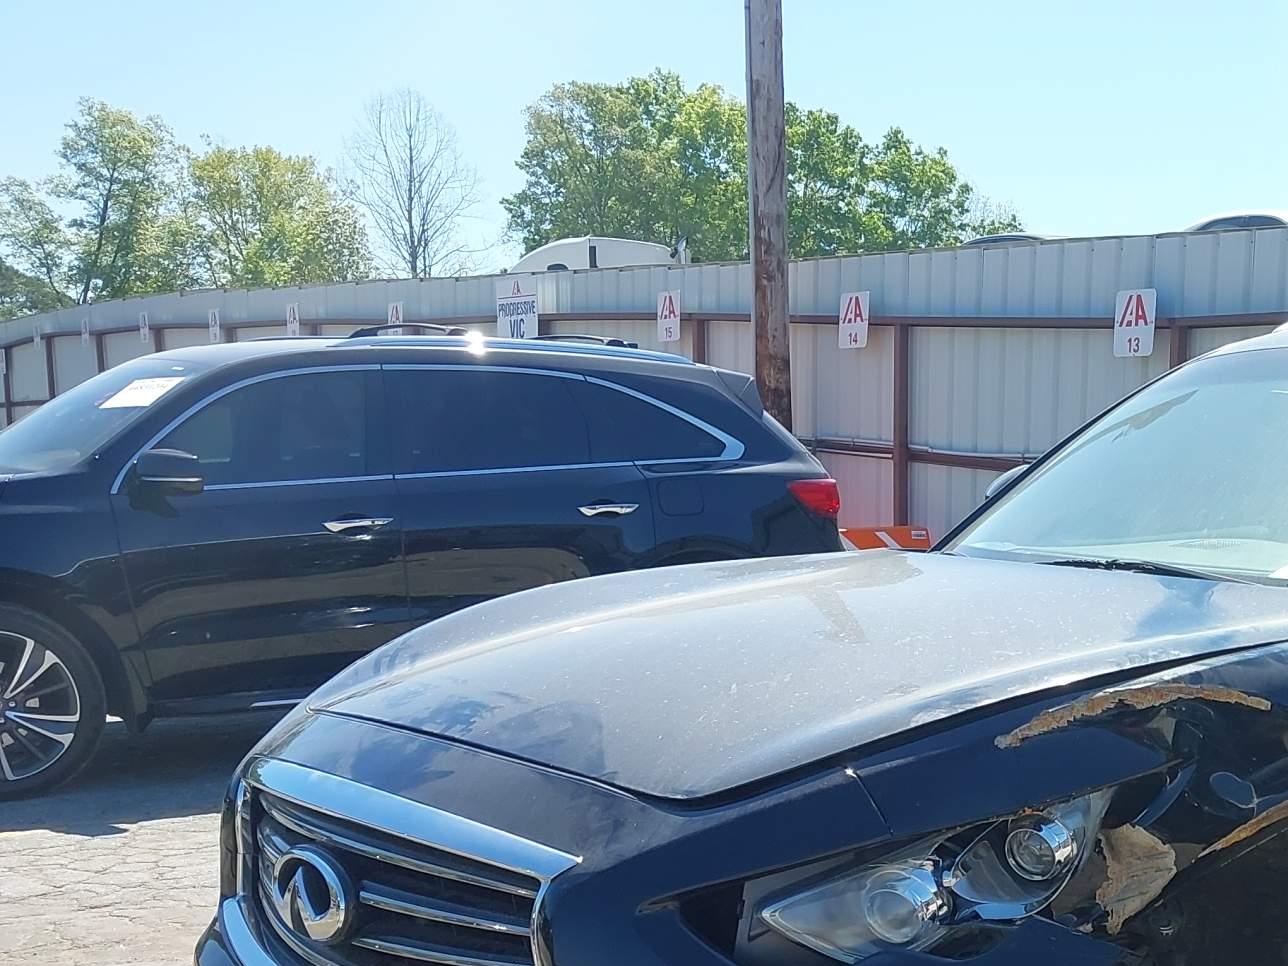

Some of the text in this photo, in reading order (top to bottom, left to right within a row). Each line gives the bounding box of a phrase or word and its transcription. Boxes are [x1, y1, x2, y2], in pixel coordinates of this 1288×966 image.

[498, 300, 536, 318] PROGRESSIVE
[509, 318, 525, 339] VIC
[848, 332, 858, 346] 14
[1127, 337, 1141, 353] 13
